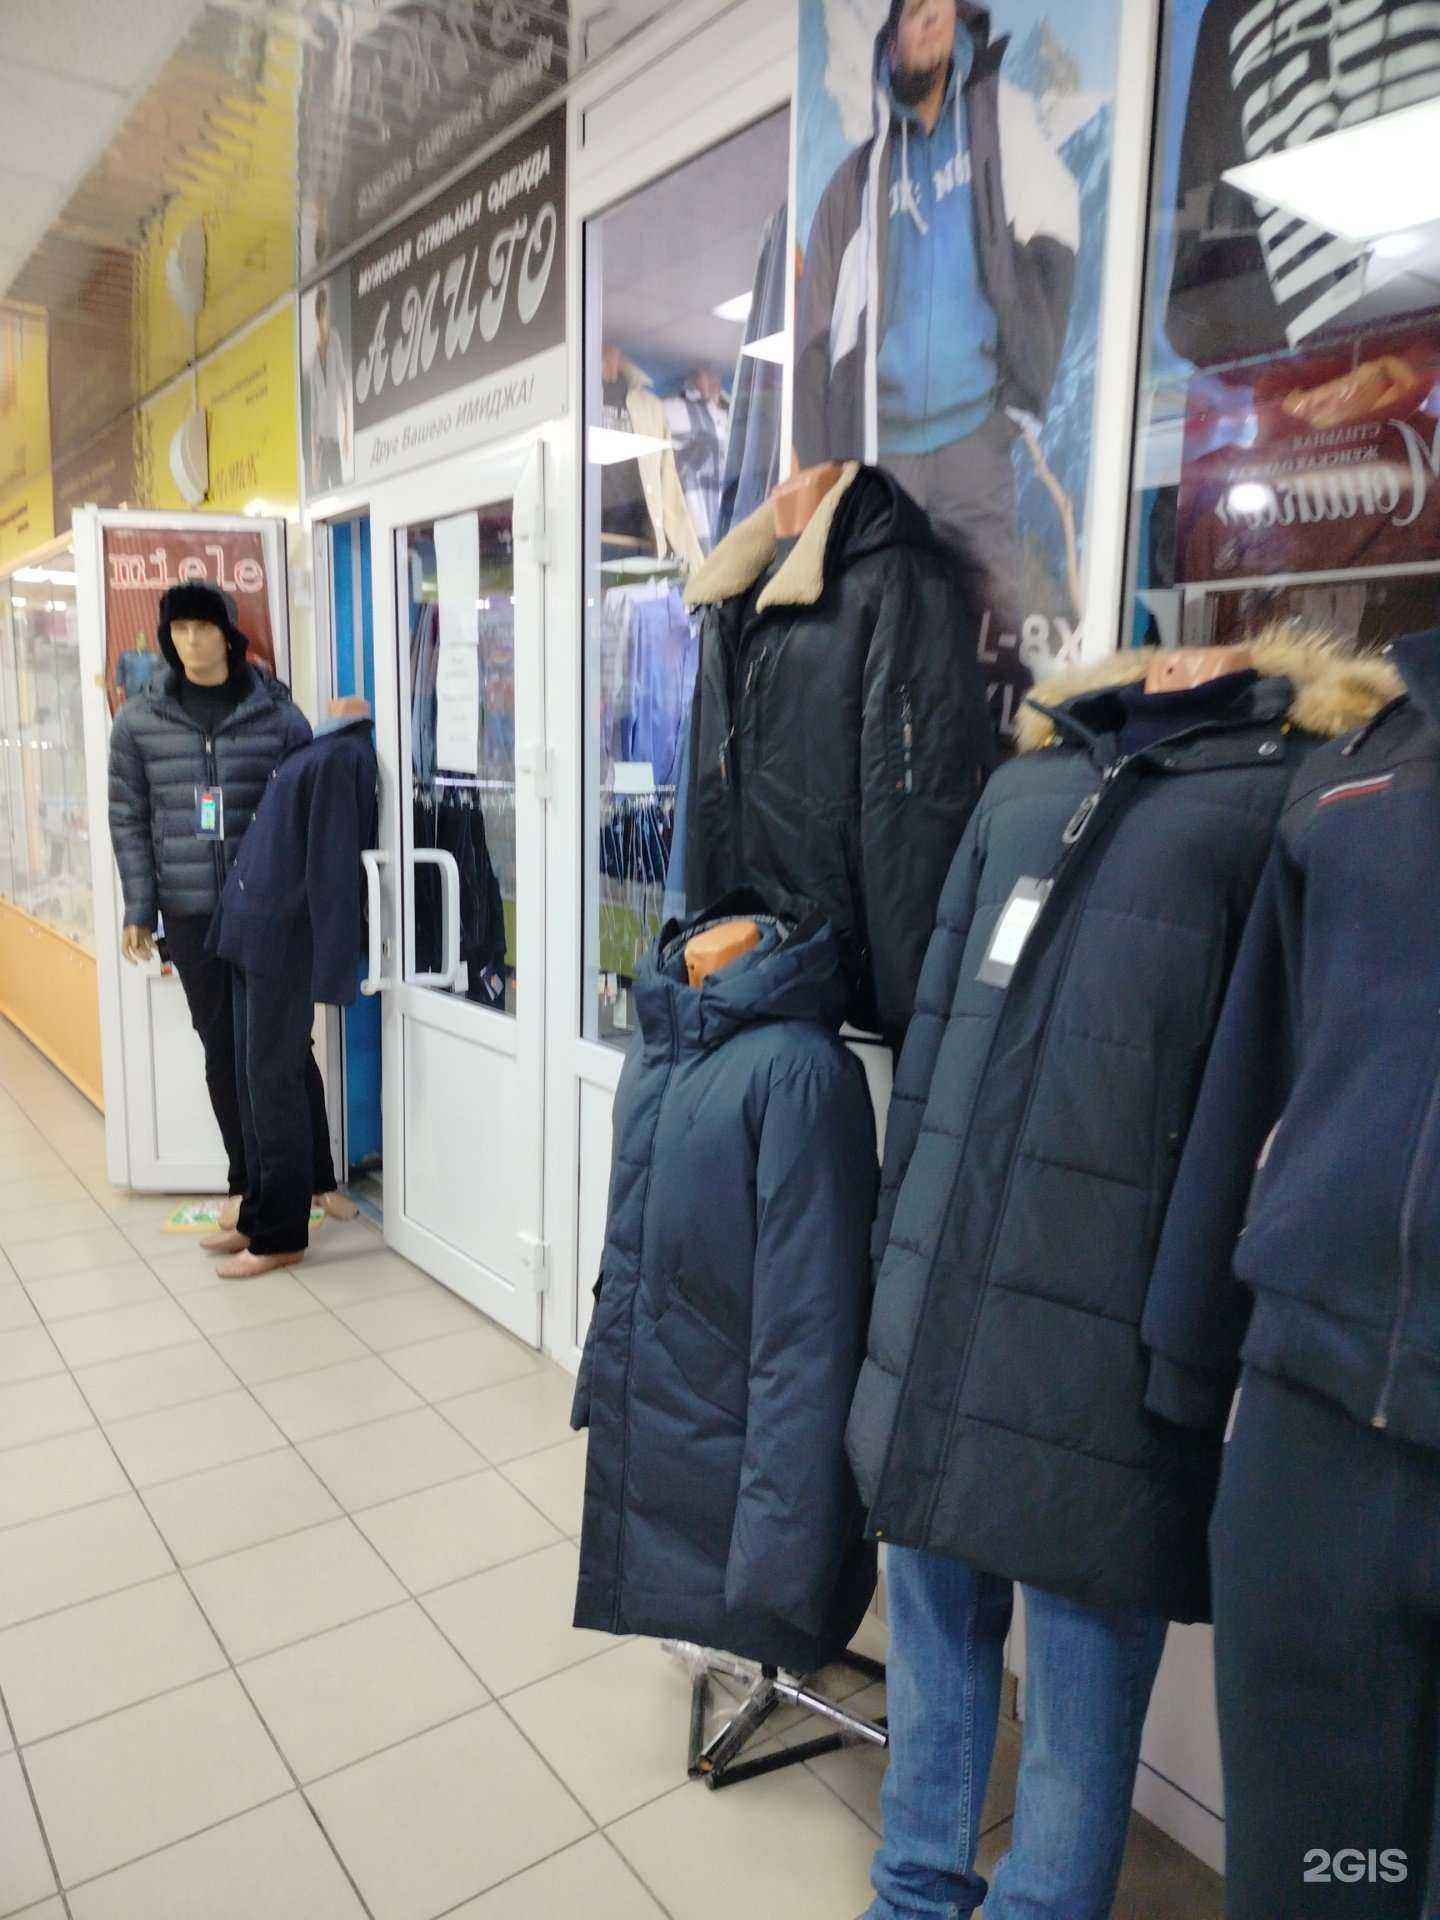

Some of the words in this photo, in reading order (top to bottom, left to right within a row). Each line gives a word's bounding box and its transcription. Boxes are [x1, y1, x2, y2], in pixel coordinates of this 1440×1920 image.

[358, 237, 412, 297] МУЖСКАЯ
[416, 190, 482, 260] СТИЛЬНАЯ
[487, 144, 551, 214] ОДЕЖДА
[108, 544, 264, 593] miele
